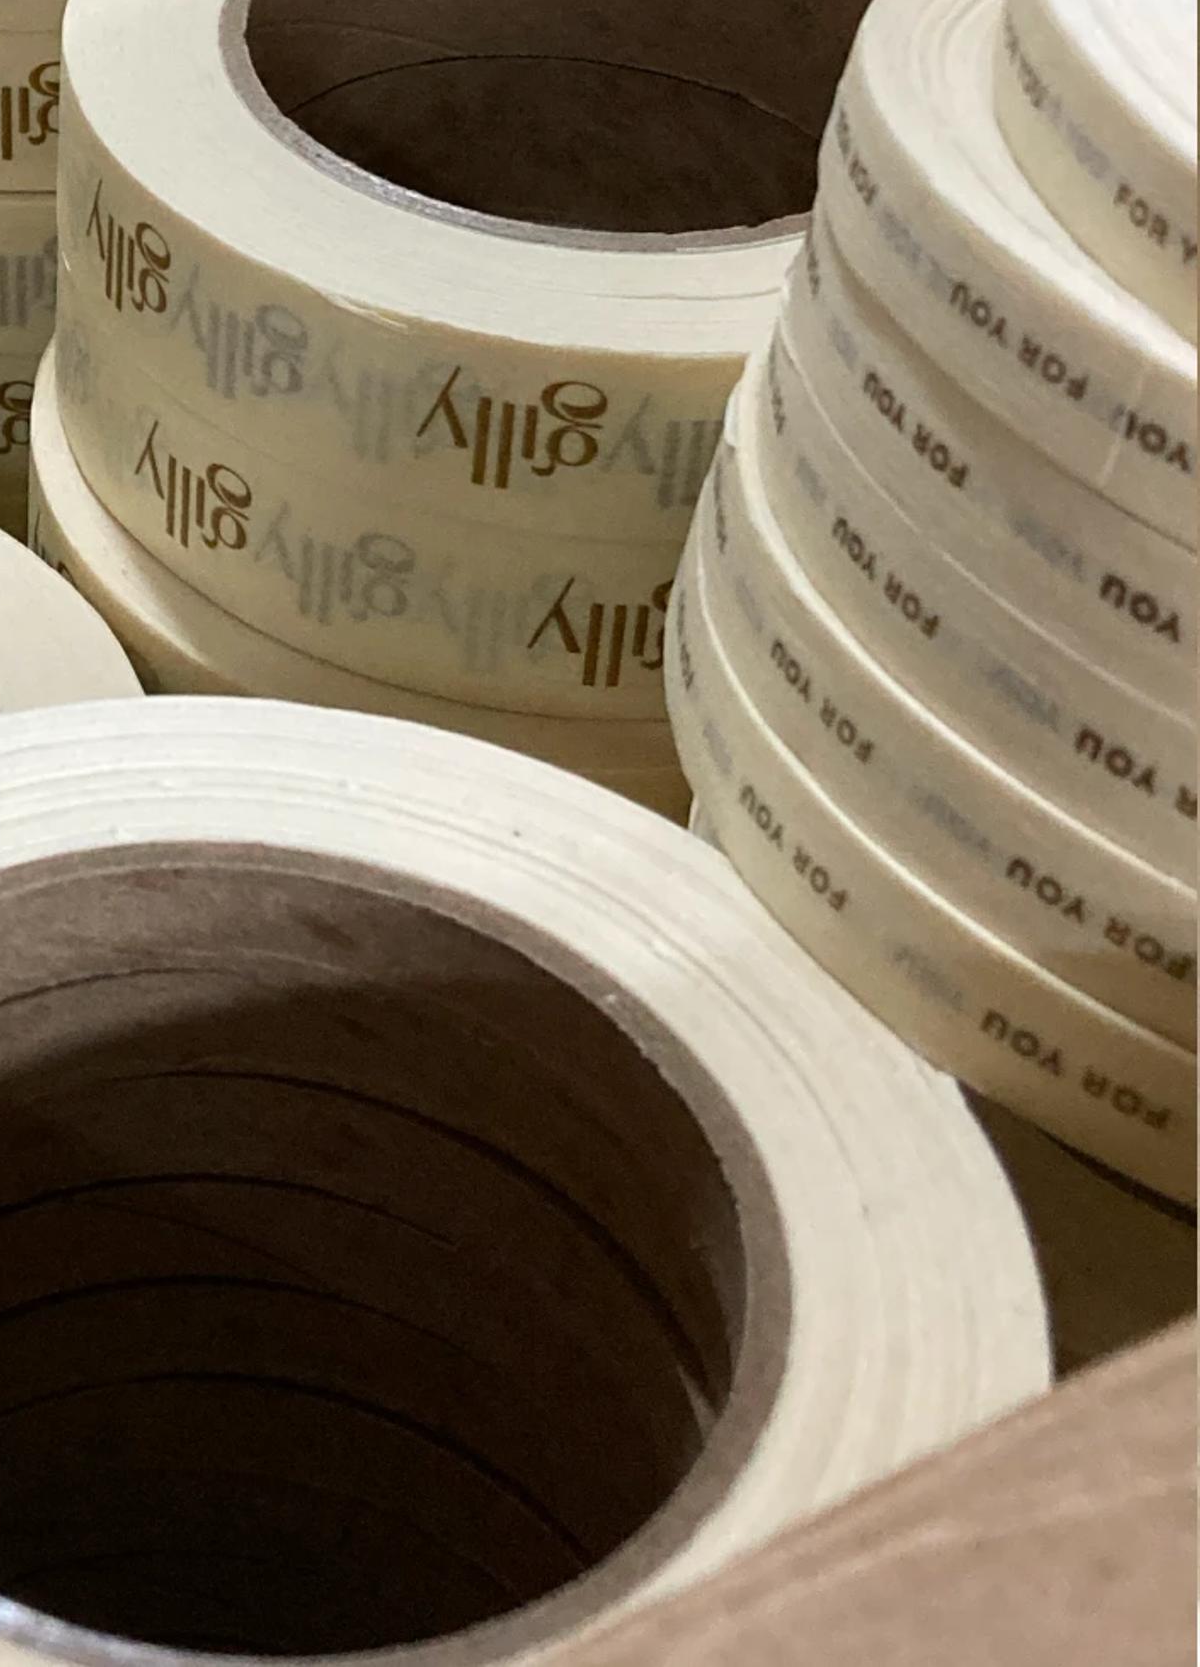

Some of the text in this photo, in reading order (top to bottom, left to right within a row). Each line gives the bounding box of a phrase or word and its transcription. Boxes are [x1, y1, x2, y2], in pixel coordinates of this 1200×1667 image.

[85, 178, 171, 314] gilly
[1112, 184, 1170, 248] FOR
[950, 280, 1090, 402] FOR YOU
[134, 419, 252, 549] gilly
[416, 365, 608, 490] gilly
[863, 371, 970, 490] FOR YOU
[832, 517, 941, 639] FOR YOU
[1099, 572, 1182, 644] YOU
[770, 638, 875, 764] FOR YOU
[1073, 724, 1157, 797] YOU
[739, 784, 848, 912] FOR YOU
[1005, 856, 1196, 981] FOR YOU
[981, 1009, 1174, 1131] FOR YOU
